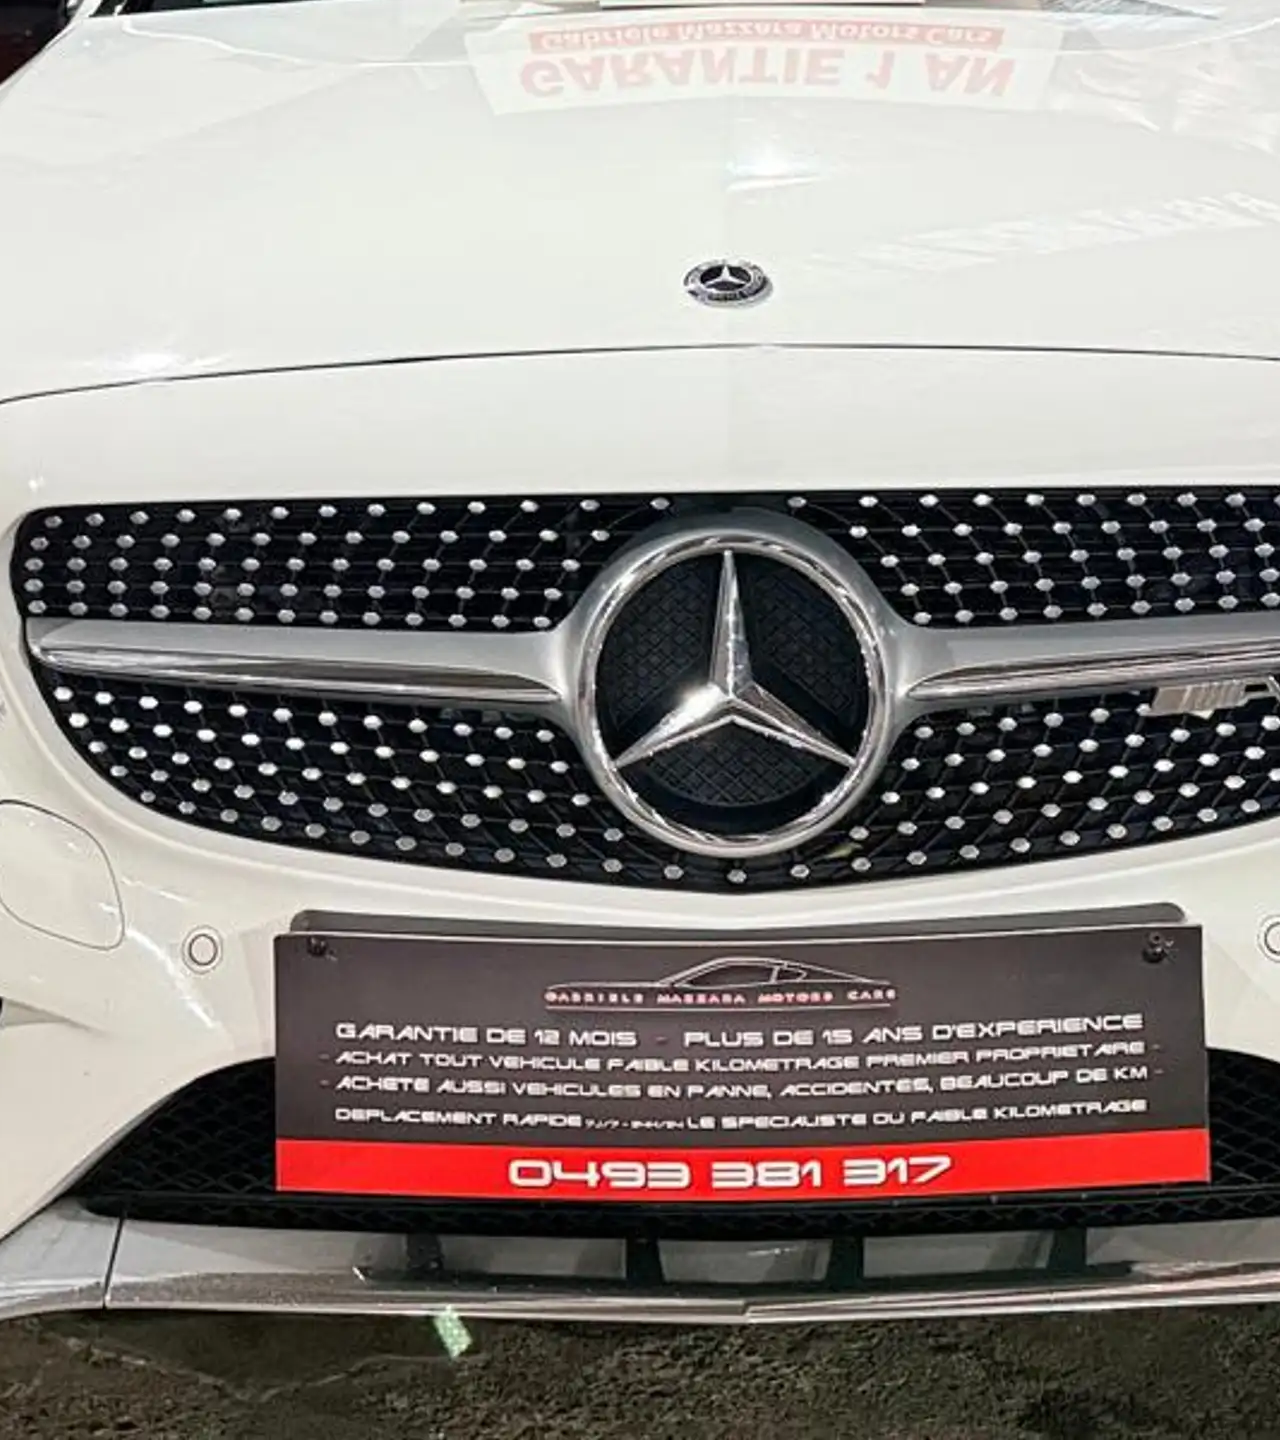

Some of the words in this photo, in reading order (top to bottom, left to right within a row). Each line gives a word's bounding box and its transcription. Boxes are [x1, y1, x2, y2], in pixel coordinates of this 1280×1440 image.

[335, 1022, 479, 1043] GARANTIE
[486, 1027, 526, 1044] DE
[534, 1028, 560, 1045] 12
[569, 1029, 637, 1047] MOIS
[684, 1031, 764, 1047] PLUS
[772, 1029, 814, 1046] DE
[822, 1028, 853, 1045] 15
[862, 1025, 923, 1043] ANS
[932, 1013, 1144, 1040] D'EXPERIENCE
[335, 1050, 413, 1065] ACHAT
[419, 1052, 483, 1068] TOUT
[489, 1054, 600, 1070] VEHICULE
[695, 1055, 859, 1072] KILOMETRAGE
[866, 1051, 970, 1068] PREMIER
[976, 1041, 1145, 1062] PROPRIETAIRE
[335, 1075, 430, 1092] ACHETE
[436, 1079, 506, 1094] AUSSI
[512, 1081, 641, 1098] VEHICULES
[647, 1084, 680, 1098] EN
[940, 1069, 1069, 1091] BEAUCOUP
[1076, 1067, 1107, 1083] DE
[1114, 1065, 1148, 1080] KM
[335, 1107, 497, 1125] DEPLACEMENT
[503, 1112, 582, 1127] RAPIDE
[687, 1116, 715, 1129] LE
[721, 1113, 866, 1130] SPECIALISTE
[873, 1111, 905, 1126] DU
[994, 1099, 1148, 1120] KILOMETRAGE
[508, 1159, 691, 1189] 0493
[711, 1159, 821, 1189] 381
[843, 1156, 951, 1186] 317
